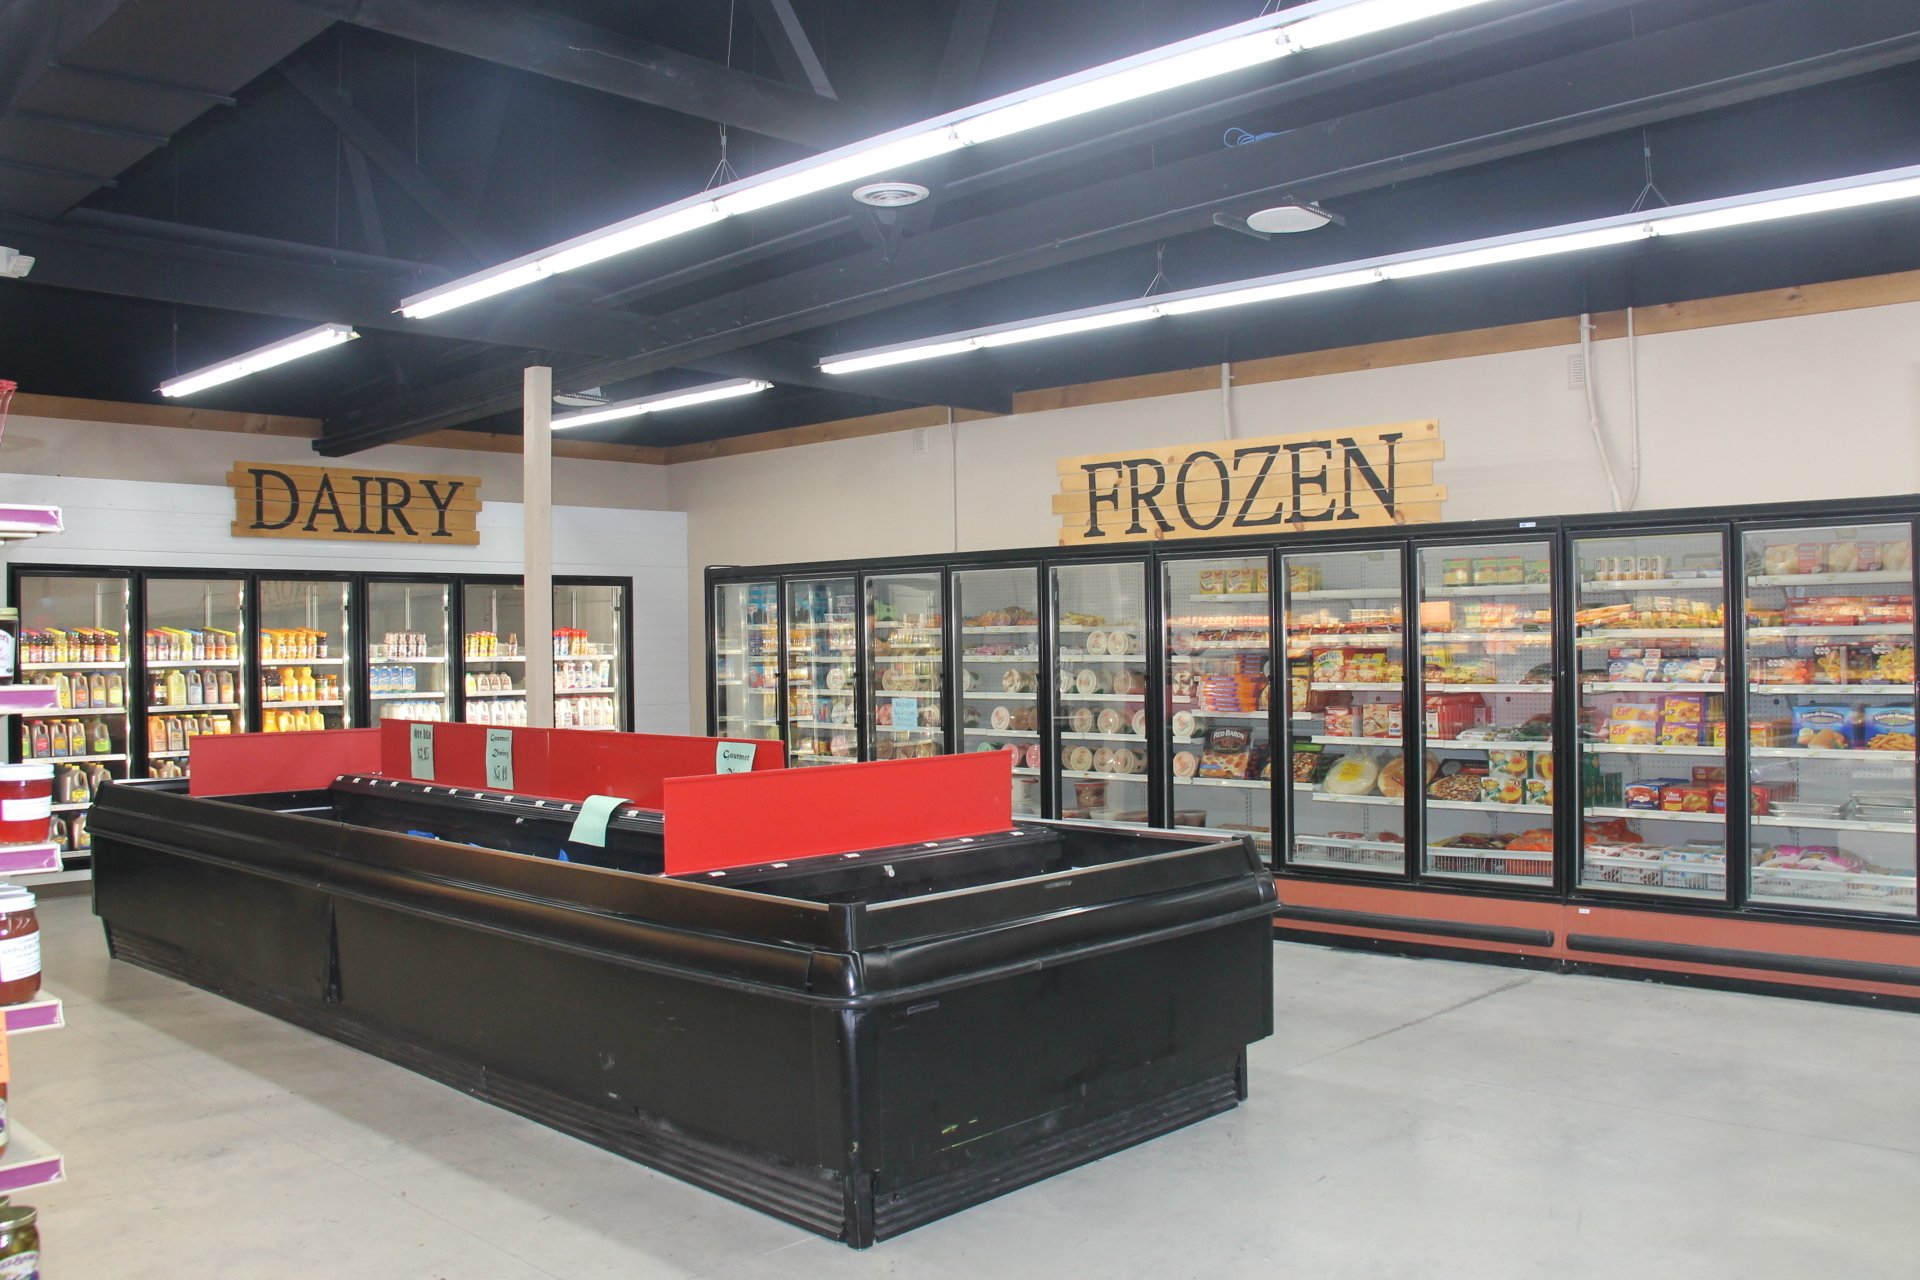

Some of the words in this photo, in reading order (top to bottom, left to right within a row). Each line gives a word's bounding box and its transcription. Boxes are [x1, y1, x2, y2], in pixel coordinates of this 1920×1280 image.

[248, 468, 464, 537] DAIRY
[1080, 432, 1403, 538] FROZEN
[722, 749, 750, 761] Gourmet
[1213, 731, 1225, 740] RED
[1225, 729, 1245, 741] BARON
